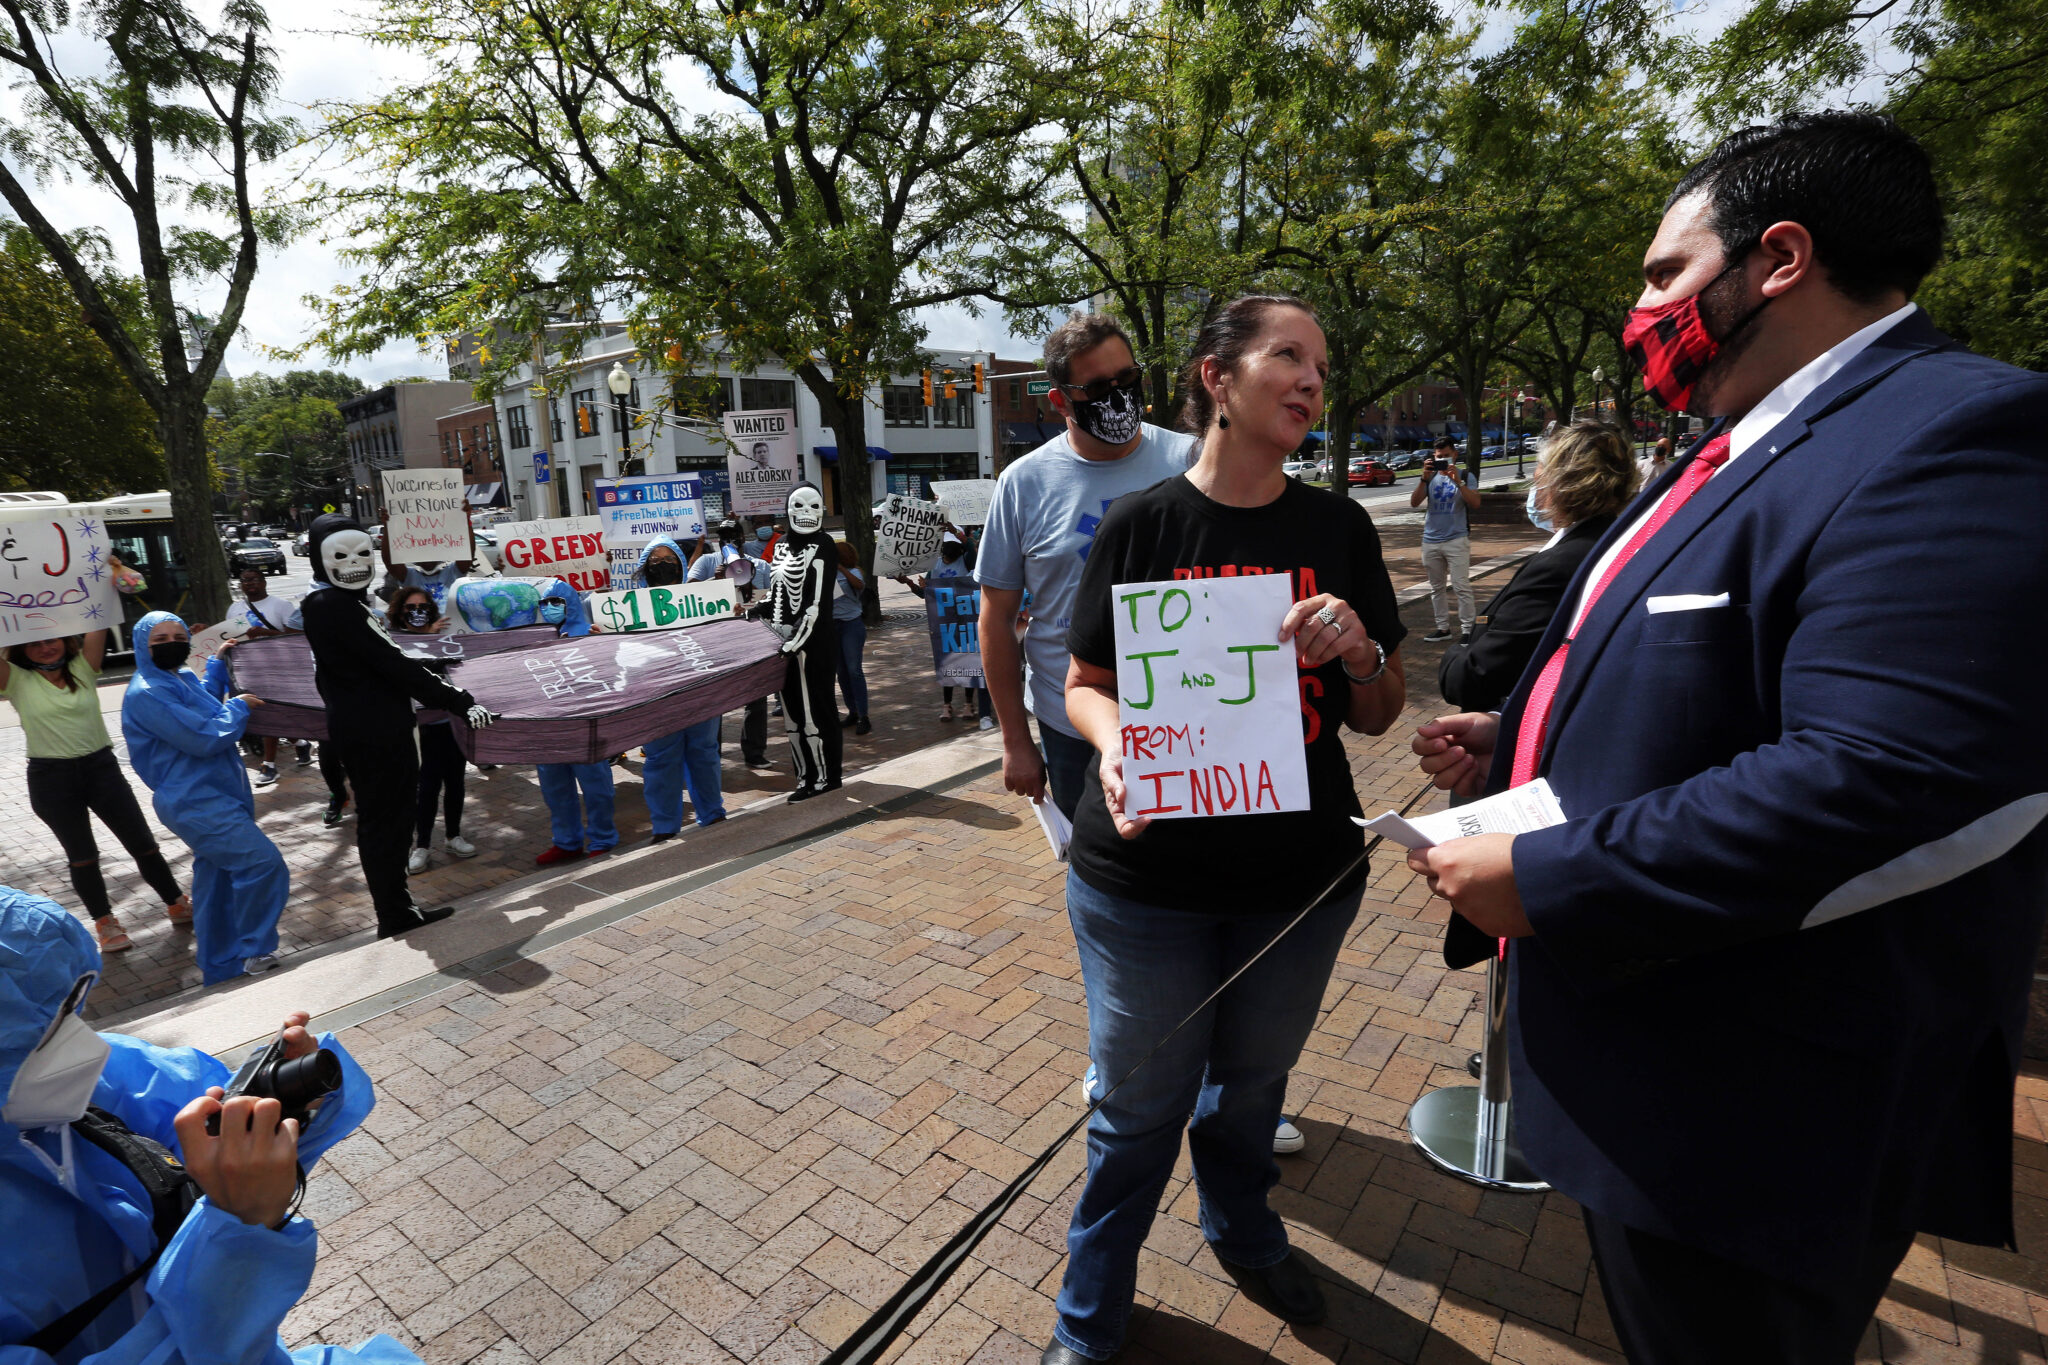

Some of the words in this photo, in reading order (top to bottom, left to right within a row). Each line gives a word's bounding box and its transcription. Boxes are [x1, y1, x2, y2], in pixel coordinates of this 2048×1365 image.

[733, 417, 785, 434] WANTED
[736, 471, 757, 484] ALEX
[758, 468, 793, 483] GORSKY
[644, 484, 669, 501] TAG
[671, 482, 693, 500] US!
[388, 497, 460, 516] EVERYONE
[611, 506, 694, 522] #FreeTheVaccine
[942, 500, 975, 510] SHARE
[405, 512, 446, 530] NOW
[631, 521, 680, 535] #VOWNow
[882, 521, 935, 542] GREED
[43, 522, 70, 577] J
[505, 531, 605, 569] GREEDY
[609, 548, 634, 560] FREE
[893, 539, 941, 557] KILLS!
[601, 590, 648, 632] $1
[649, 588, 731, 627] Billion
[1120, 588, 1210, 635] TO:
[523, 657, 576, 701] RIP
[555, 646, 613, 700] LATIN
[1123, 648, 1180, 711] J
[1181, 671, 1216, 689] AND
[1217, 643, 1281, 706] J
[1120, 723, 1206, 761] FROM:
[1136, 760, 1281, 816] INDIA
